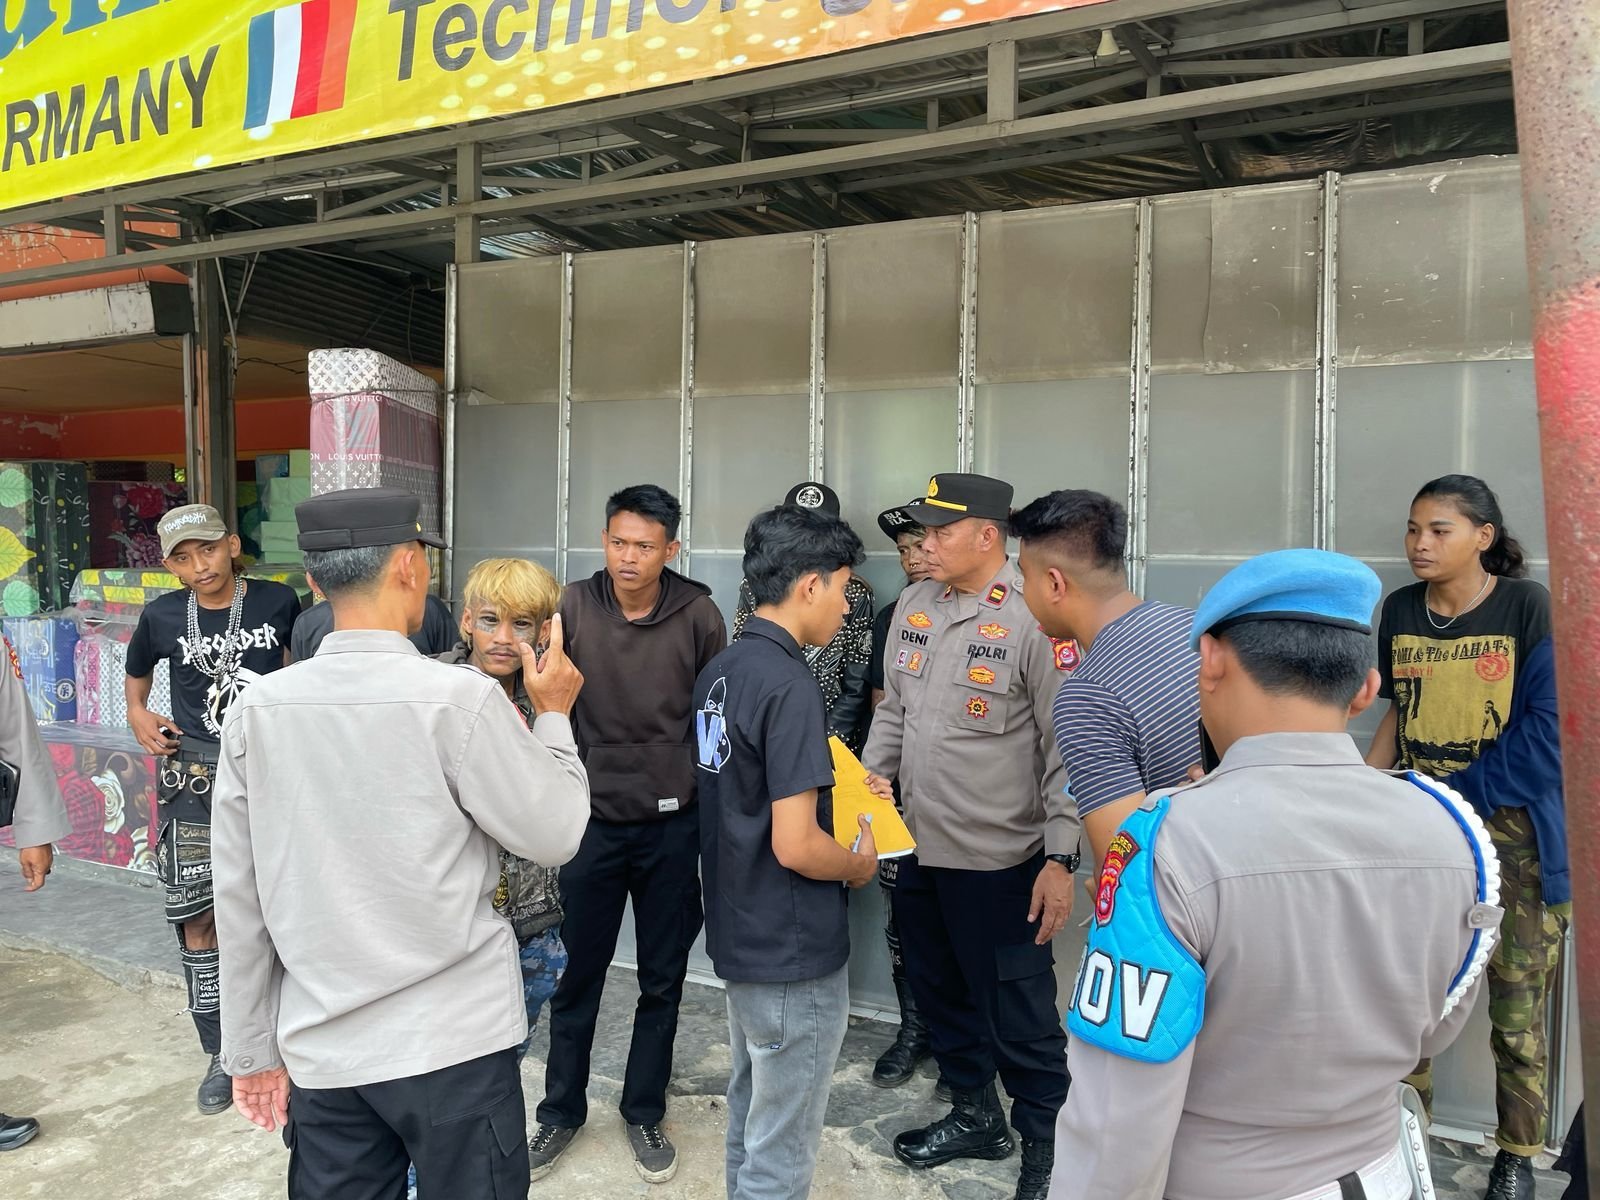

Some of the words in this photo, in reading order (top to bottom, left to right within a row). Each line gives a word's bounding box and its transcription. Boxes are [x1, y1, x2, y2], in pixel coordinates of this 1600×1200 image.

[328, 453, 354, 461] LOUIS
[901, 629, 929, 647] DENI
[967, 643, 1007, 661] POLRI
[1425, 646, 1449, 662] The
